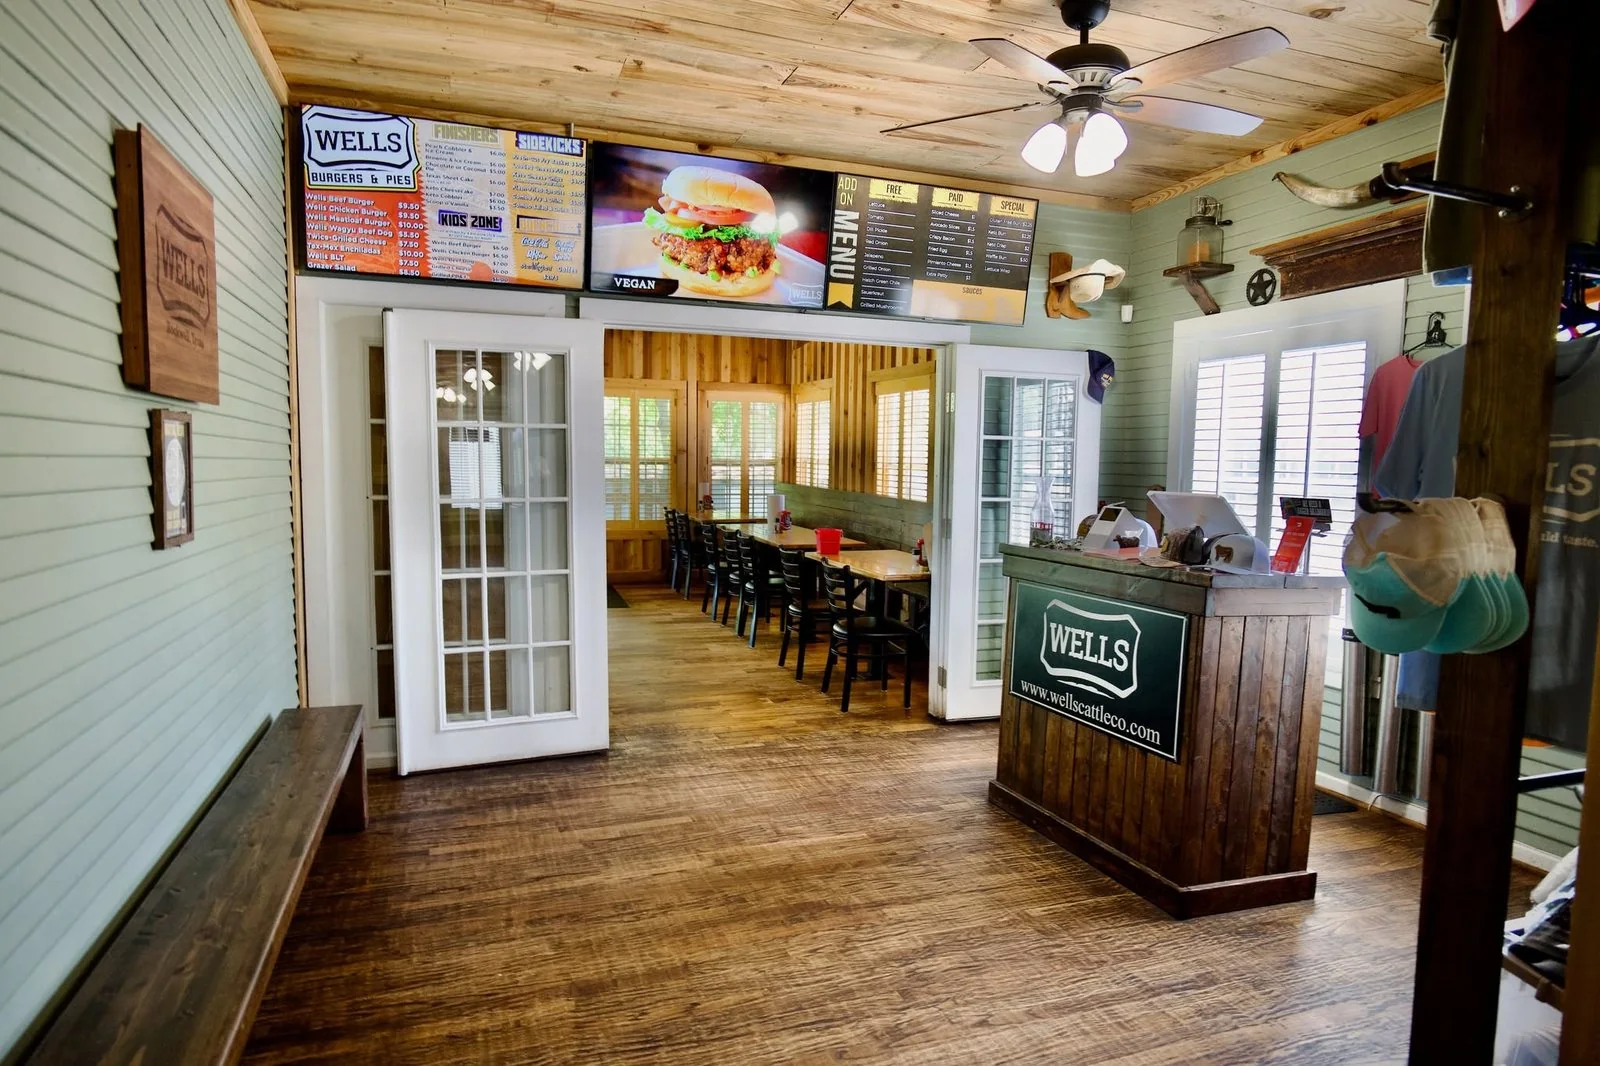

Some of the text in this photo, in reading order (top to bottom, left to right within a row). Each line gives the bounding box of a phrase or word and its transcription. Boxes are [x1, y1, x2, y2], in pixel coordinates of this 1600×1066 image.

[434, 124, 498, 142] FINISHERS
[315, 130, 401, 152] WELLS
[519, 134, 581, 154] SIDEKICKS
[312, 173, 411, 184] BURGERS & PIES
[838, 177, 857, 191] ADD
[887, 184, 902, 195] FREE
[306, 193, 374, 206] Wells Beef Burger
[840, 193, 853, 205] ON
[949, 192, 964, 203] PAID
[306, 203, 327, 211] Wells
[329, 205, 359, 214] Chicken
[398, 202, 419, 210] $9.50
[1001, 201, 1025, 212] SPECIAL
[306, 213, 390, 227] Wells Meatloaf Burger
[398, 221, 424, 229] $10.00
[441, 214, 499, 228] KIDS ZONE
[306, 223, 393, 237] Wells Wagyu Beef Dog
[360, 237, 387, 245] Cheese
[830, 210, 859, 280] MENU
[307, 242, 381, 254] Tex-Mex Enchiladas
[307, 252, 328, 260] Wells
[160, 236, 206, 299] WELLS
[308, 262, 333, 270] Grazer
[614, 278, 655, 289] VEGAN
[792, 289, 822, 299] WELLS
[1050, 623, 1130, 671] WELLS
[1021, 680, 1161, 745] www.wellscattleco.com
